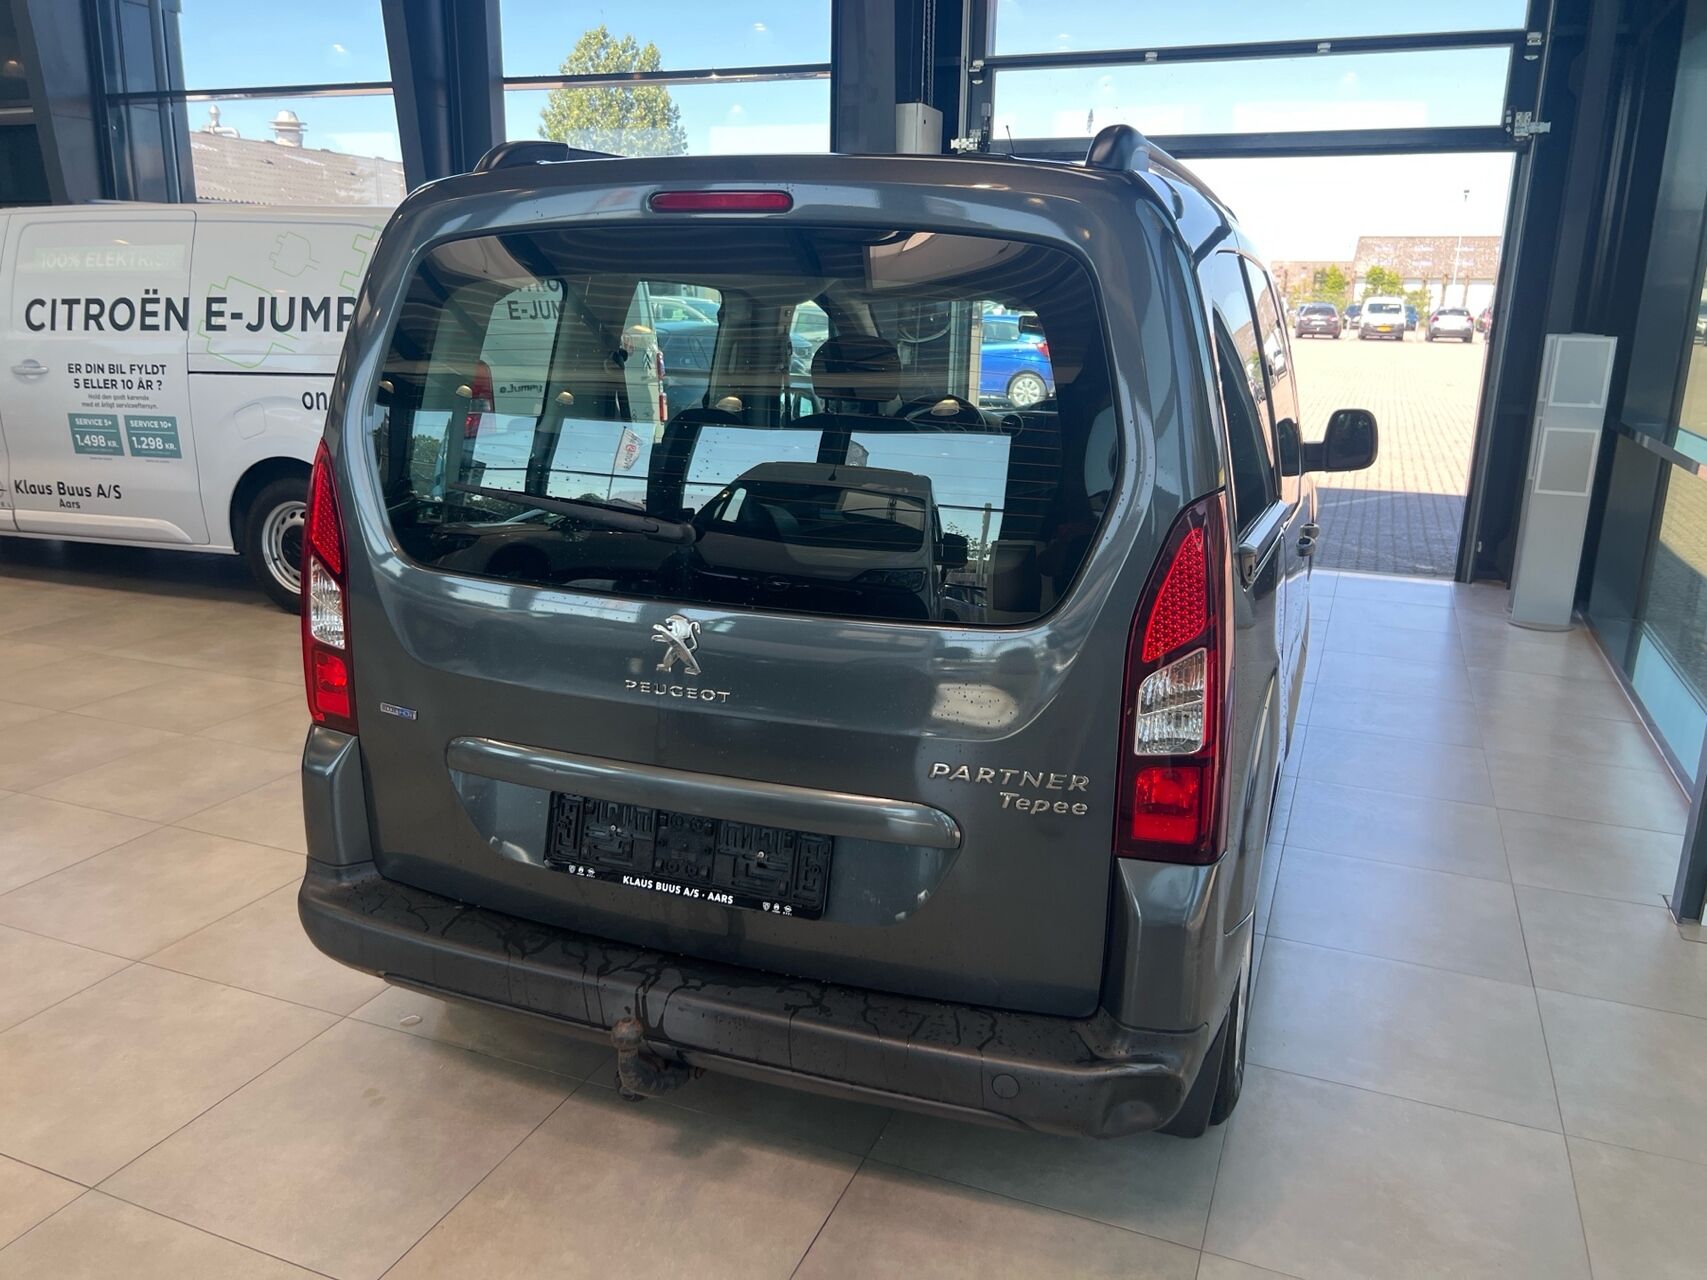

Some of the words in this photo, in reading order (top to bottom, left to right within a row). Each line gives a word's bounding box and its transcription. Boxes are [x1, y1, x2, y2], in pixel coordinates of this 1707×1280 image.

[25, 288, 190, 332] CITROËN
[67, 363, 82, 374] ER
[85, 363, 105, 374] DIN
[108, 363, 126, 375] BIL
[129, 364, 166, 375] FYLDT
[73, 378, 80, 389] 5
[83, 379, 118, 389] ELLER
[121, 379, 133, 390] 10
[137, 377, 153, 390] ÅR
[74, 418, 103, 426] SERVICE
[129, 420, 159, 428] SERVICE
[75, 434, 106, 447] 1.498
[131, 436, 163, 450] 1.298
[14, 480, 53, 496] Klaus
[57, 481, 92, 497] Buus
[97, 484, 122, 499] A/S
[59, 498, 81, 509] Aars
[625, 679, 731, 703] PEUGEOT
[929, 762, 1090, 792] PARTNER
[1000, 791, 1088, 816] Tepee
[622, 875, 653, 889] KLAUS
[655, 881, 681, 895] BUUS
[683, 887, 700, 898] A/S
[707, 892, 734, 905] AARS
